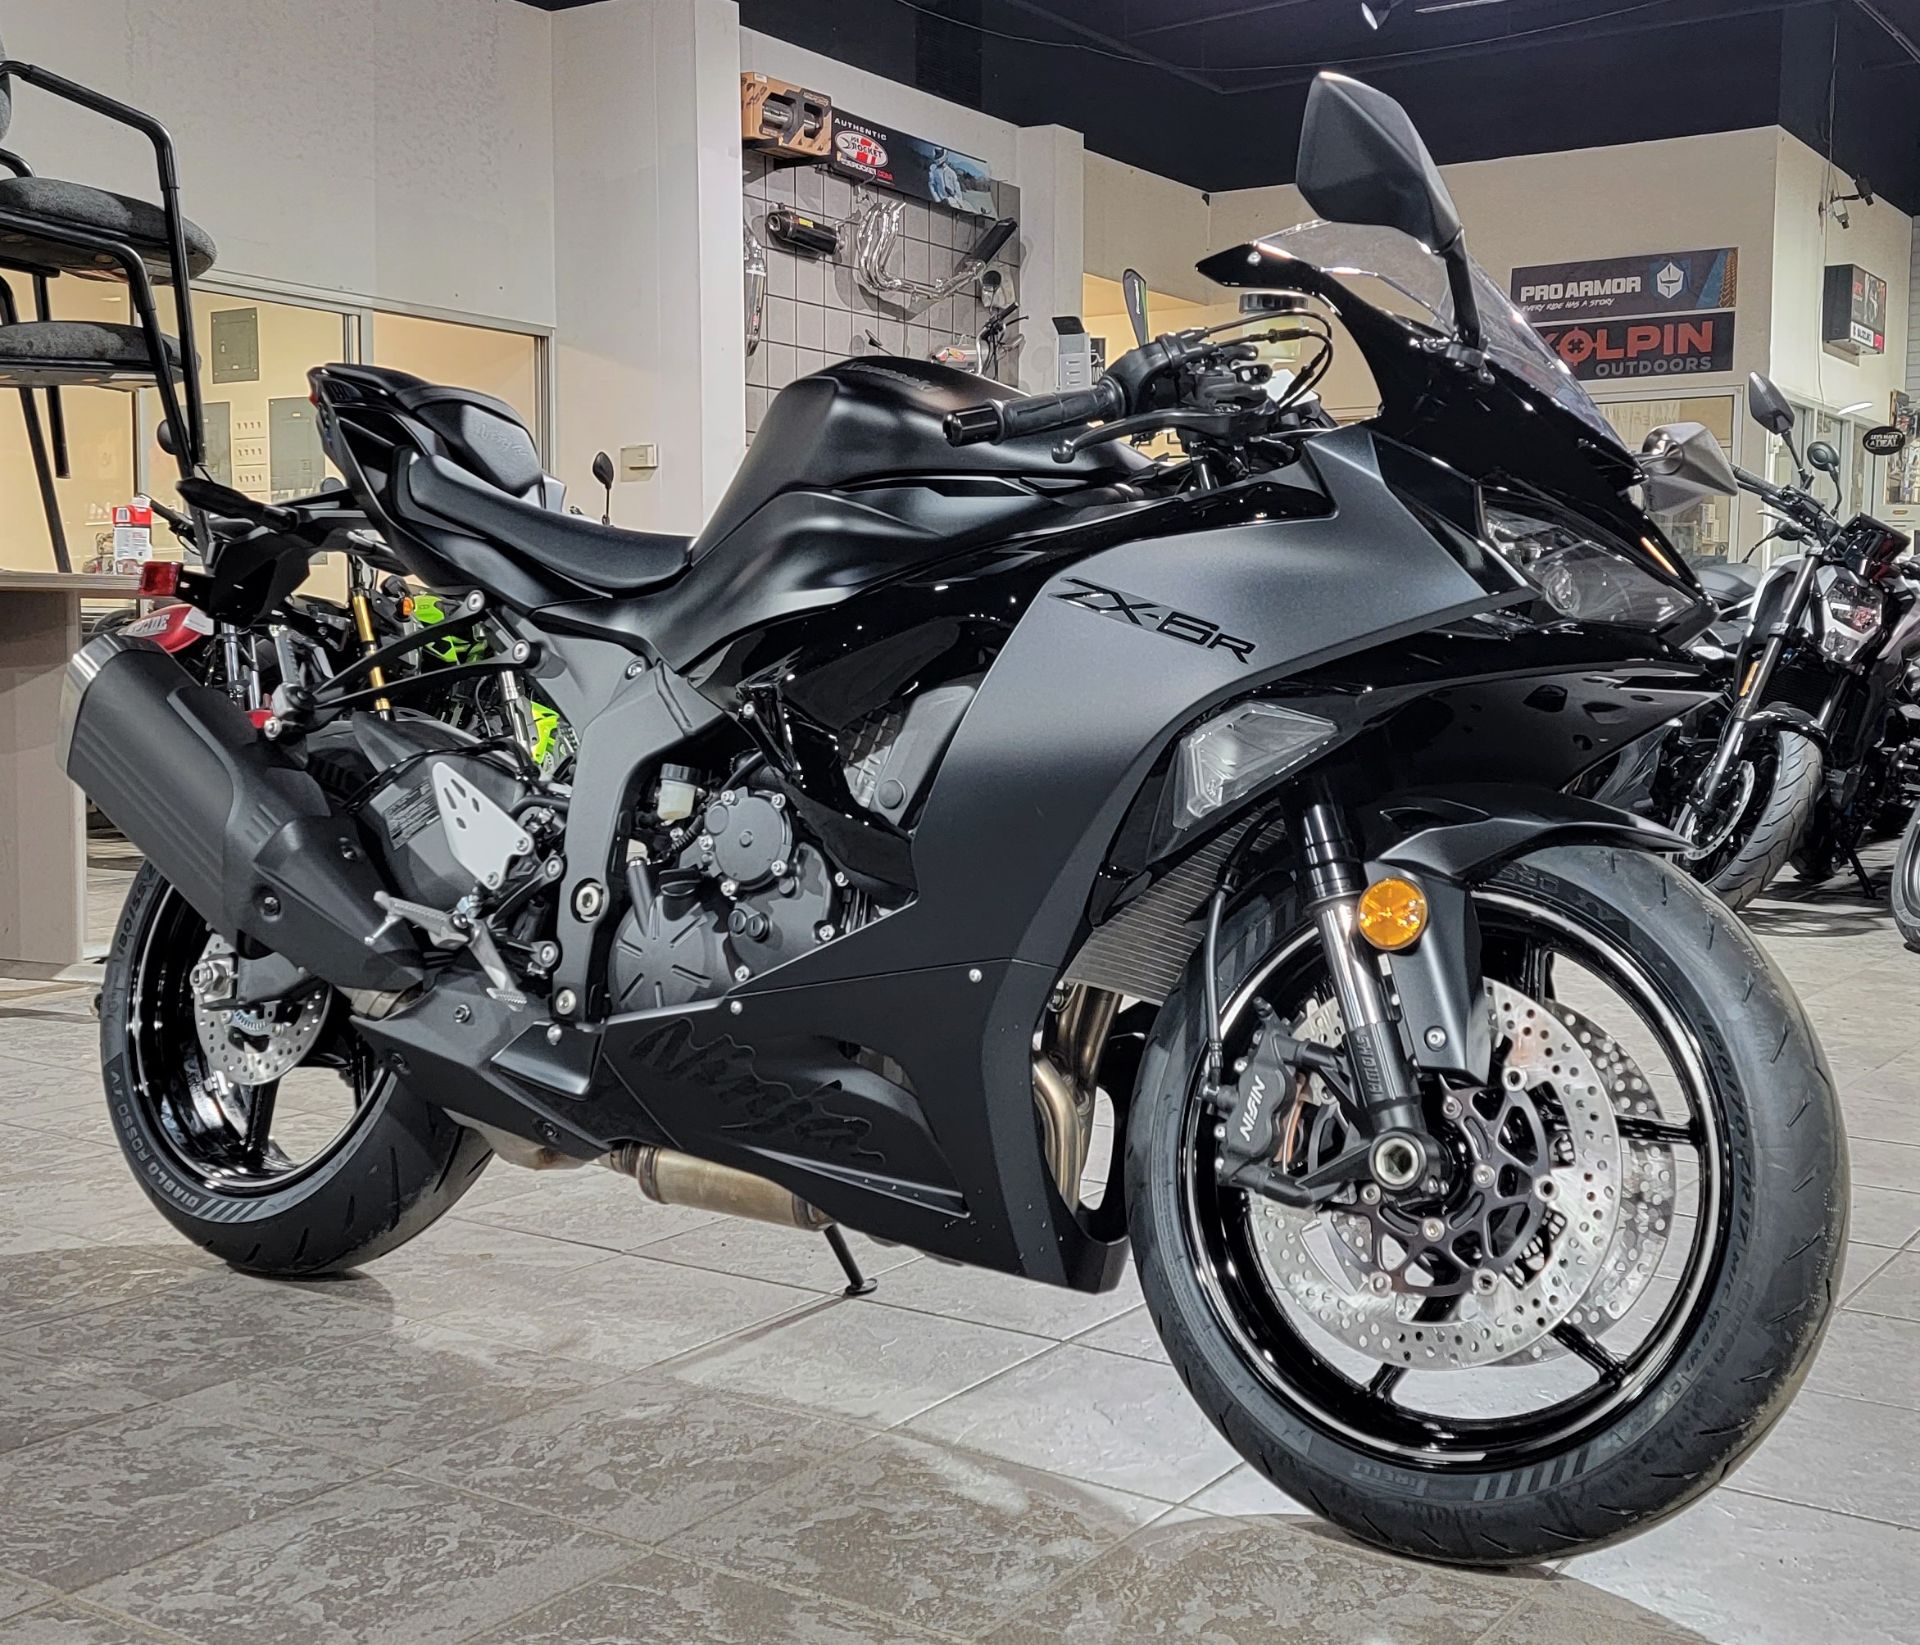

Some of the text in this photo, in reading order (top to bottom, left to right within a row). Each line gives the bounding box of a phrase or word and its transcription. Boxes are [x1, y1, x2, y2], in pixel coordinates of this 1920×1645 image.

[834, 117, 888, 141] AUTHENTIC
[851, 142, 883, 158] ROCKET
[1520, 276, 1642, 302] PRO ARMOR
[1520, 304, 1546, 313] EVERY
[1546, 302, 1563, 311] RIDE
[1565, 301, 1580, 309] HAS
[1588, 298, 1616, 306] STORY
[1595, 356, 1712, 377] OUTDOORS
[1875, 439, 1899, 448] DEAL
[1049, 577, 1256, 664] ZX-6R
[117, 1103, 151, 1161] ROSSO
[148, 1161, 200, 1208] DIABLO
